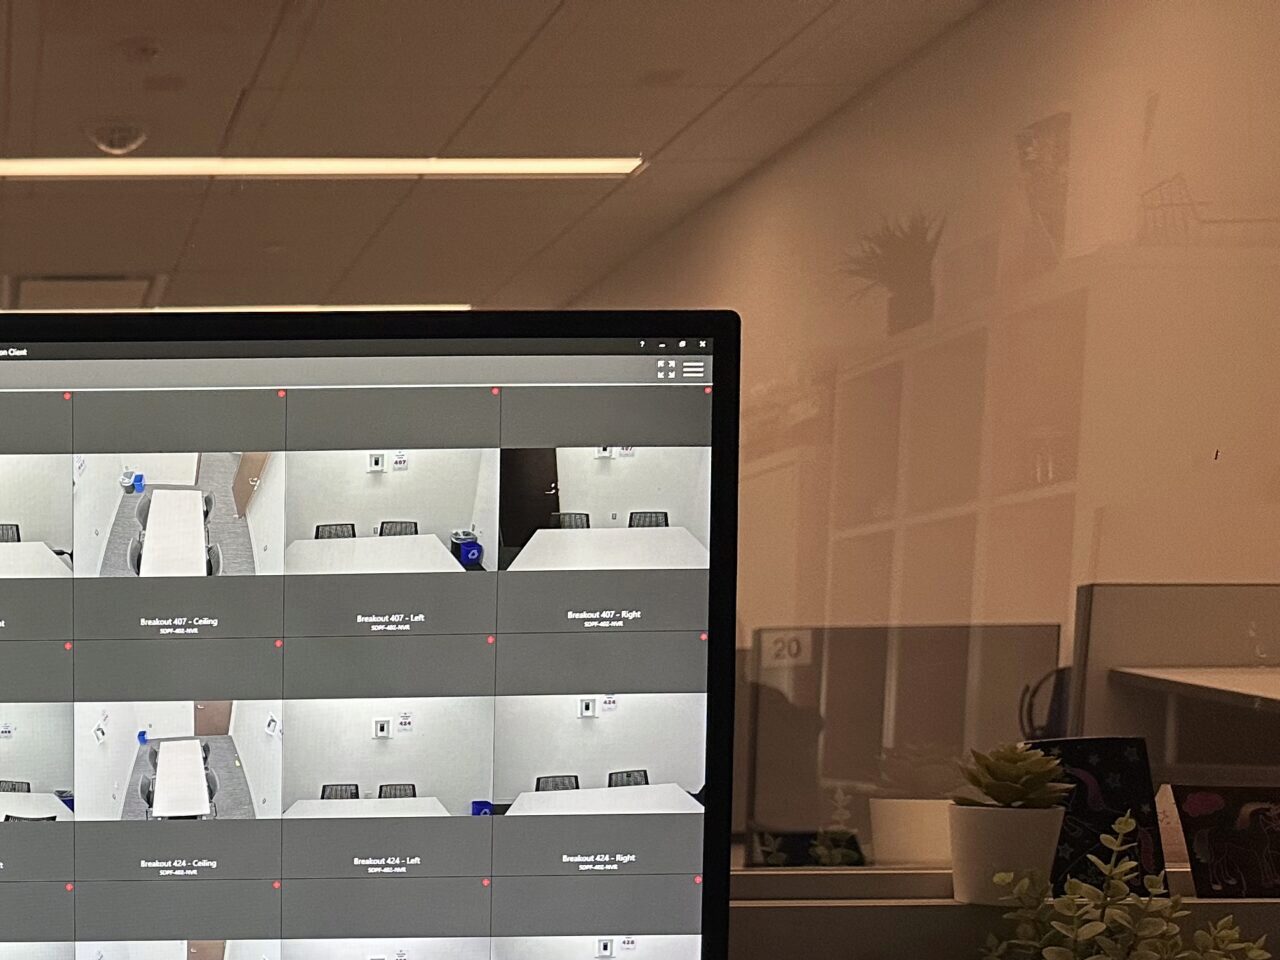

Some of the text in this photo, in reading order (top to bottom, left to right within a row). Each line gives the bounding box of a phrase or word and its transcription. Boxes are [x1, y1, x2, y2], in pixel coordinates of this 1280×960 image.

[8, 348, 28, 356] Client
[357, 614, 424, 622] Breakout 407 Left
[568, 611, 599, 619] Breakout
[622, 611, 641, 619] Right
[141, 618, 172, 626] Breakout
[194, 618, 218, 626] Ceiling
[773, 637, 801, 660] 20
[354, 857, 420, 865] Breakout 424 Left
[563, 854, 635, 863] Breakout 424 Right
[141, 860, 171, 868] Breakout
[193, 860, 216, 868] Ceiling
